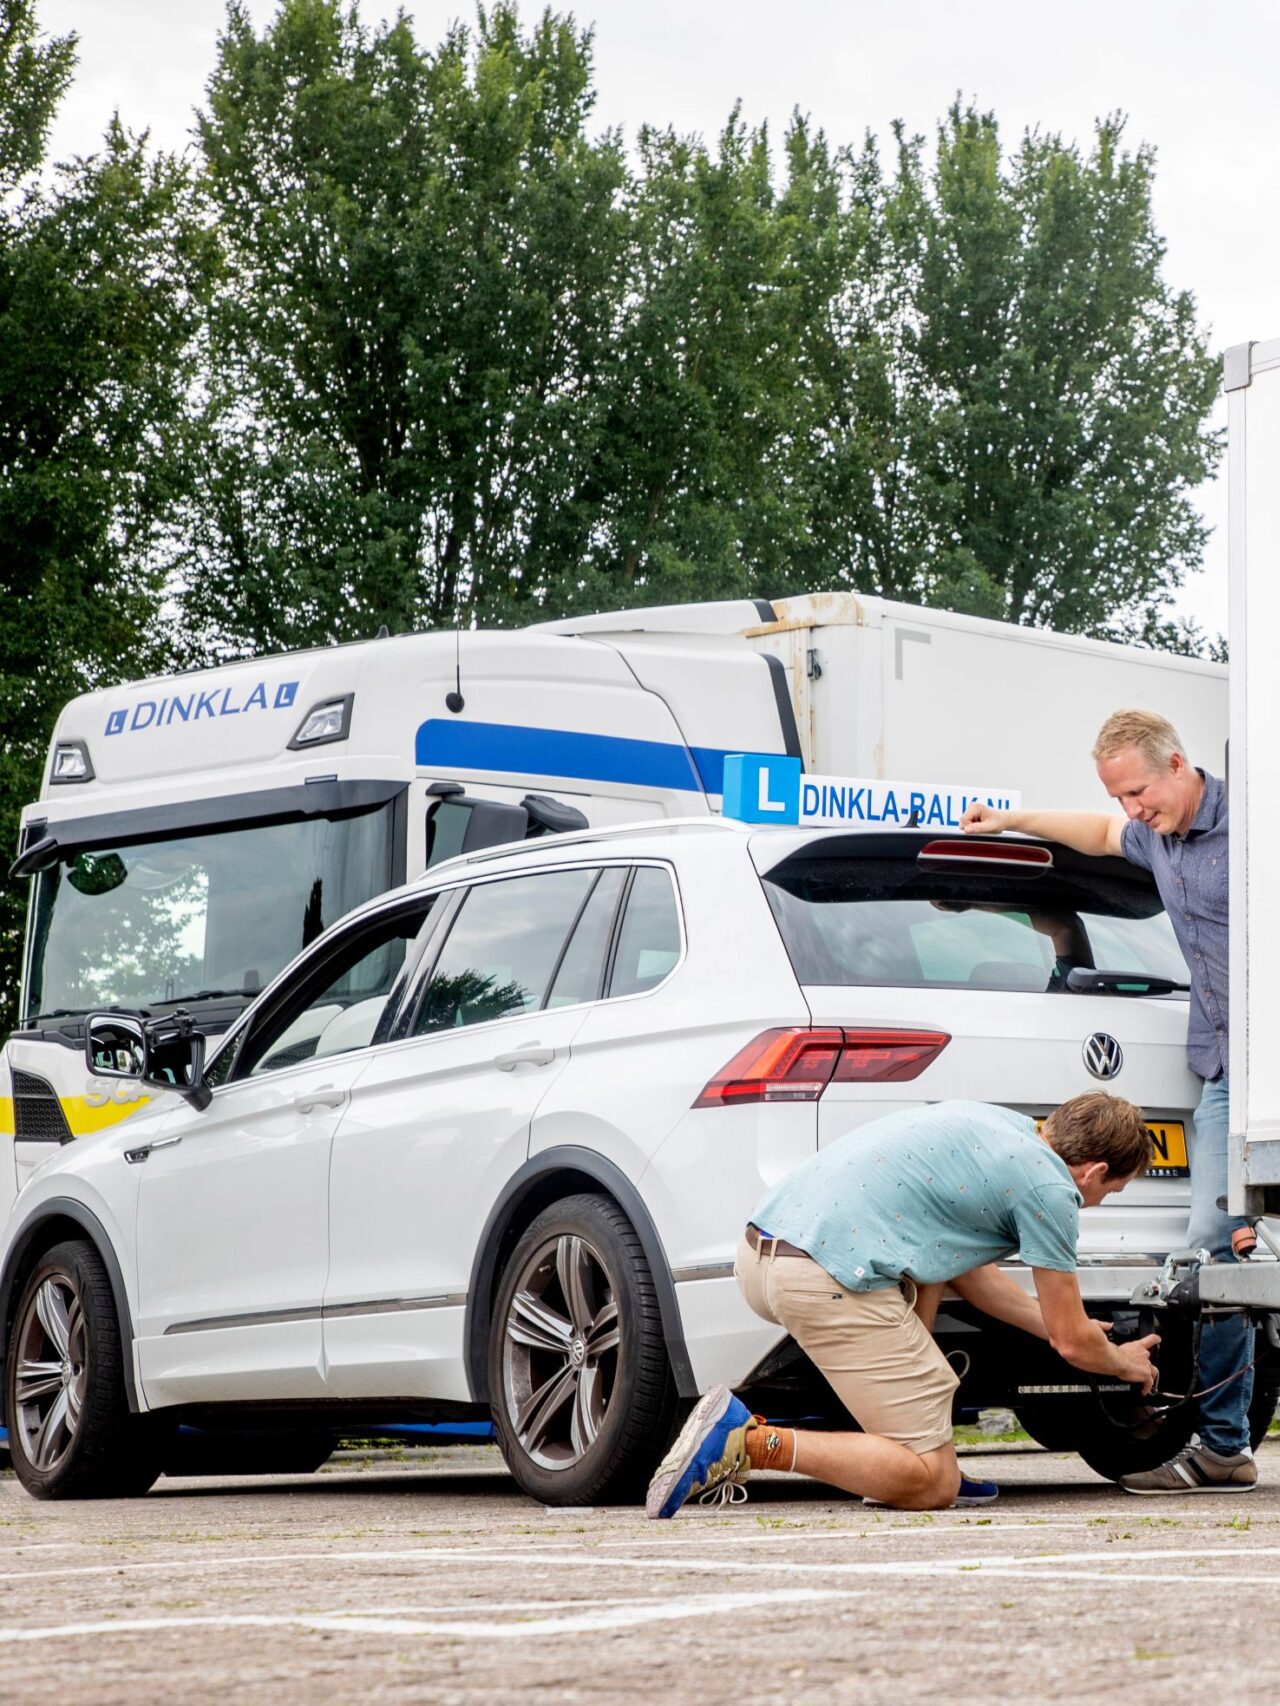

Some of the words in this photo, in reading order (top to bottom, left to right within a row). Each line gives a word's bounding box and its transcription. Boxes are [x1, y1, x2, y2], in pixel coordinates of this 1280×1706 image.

[130, 682, 268, 731] DINKLA
[758, 767, 785, 812] L
[802, 783, 1010, 827] DINKLA-BAL
